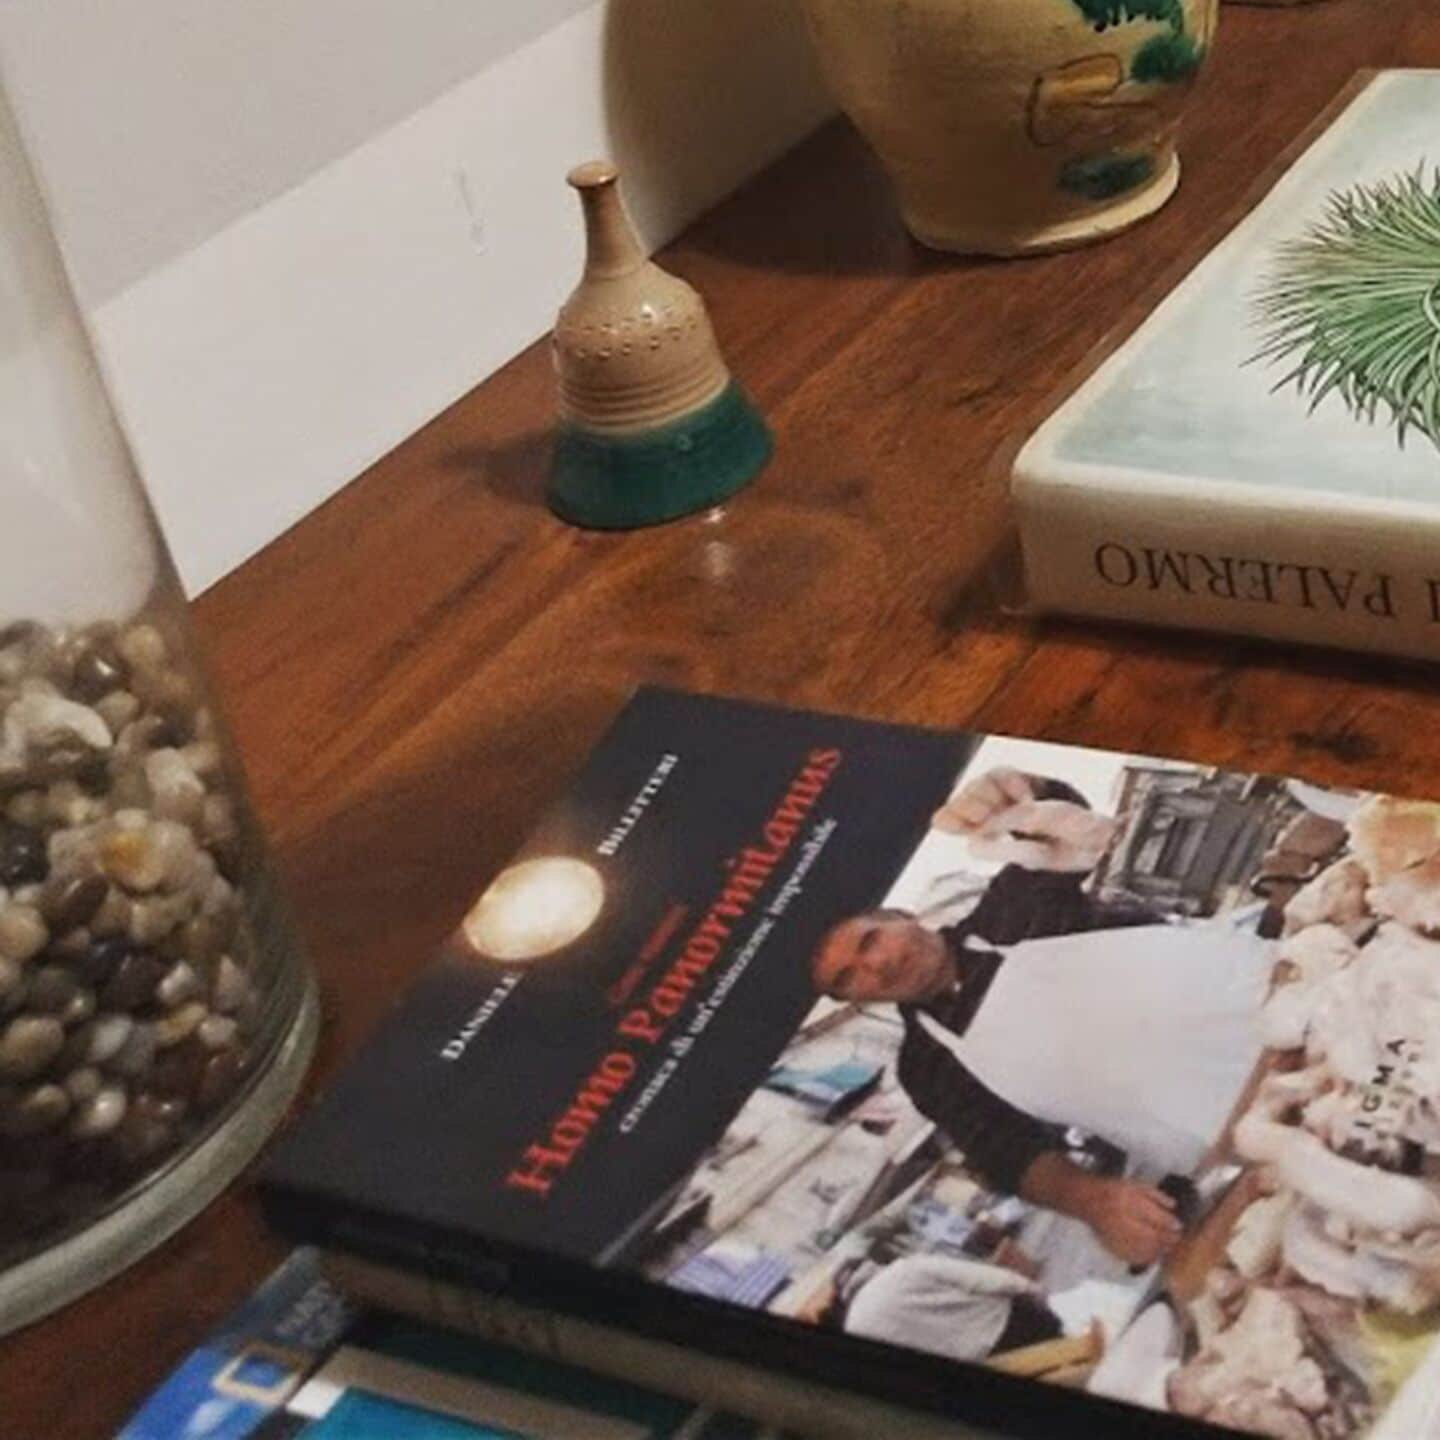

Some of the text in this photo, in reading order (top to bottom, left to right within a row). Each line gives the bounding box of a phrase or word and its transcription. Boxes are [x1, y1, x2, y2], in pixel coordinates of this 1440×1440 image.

[1093, 541, 1393, 618] PALERMO
[504, 1049, 638, 1197] Homo
[617, 747, 842, 1045] Panormitanus
